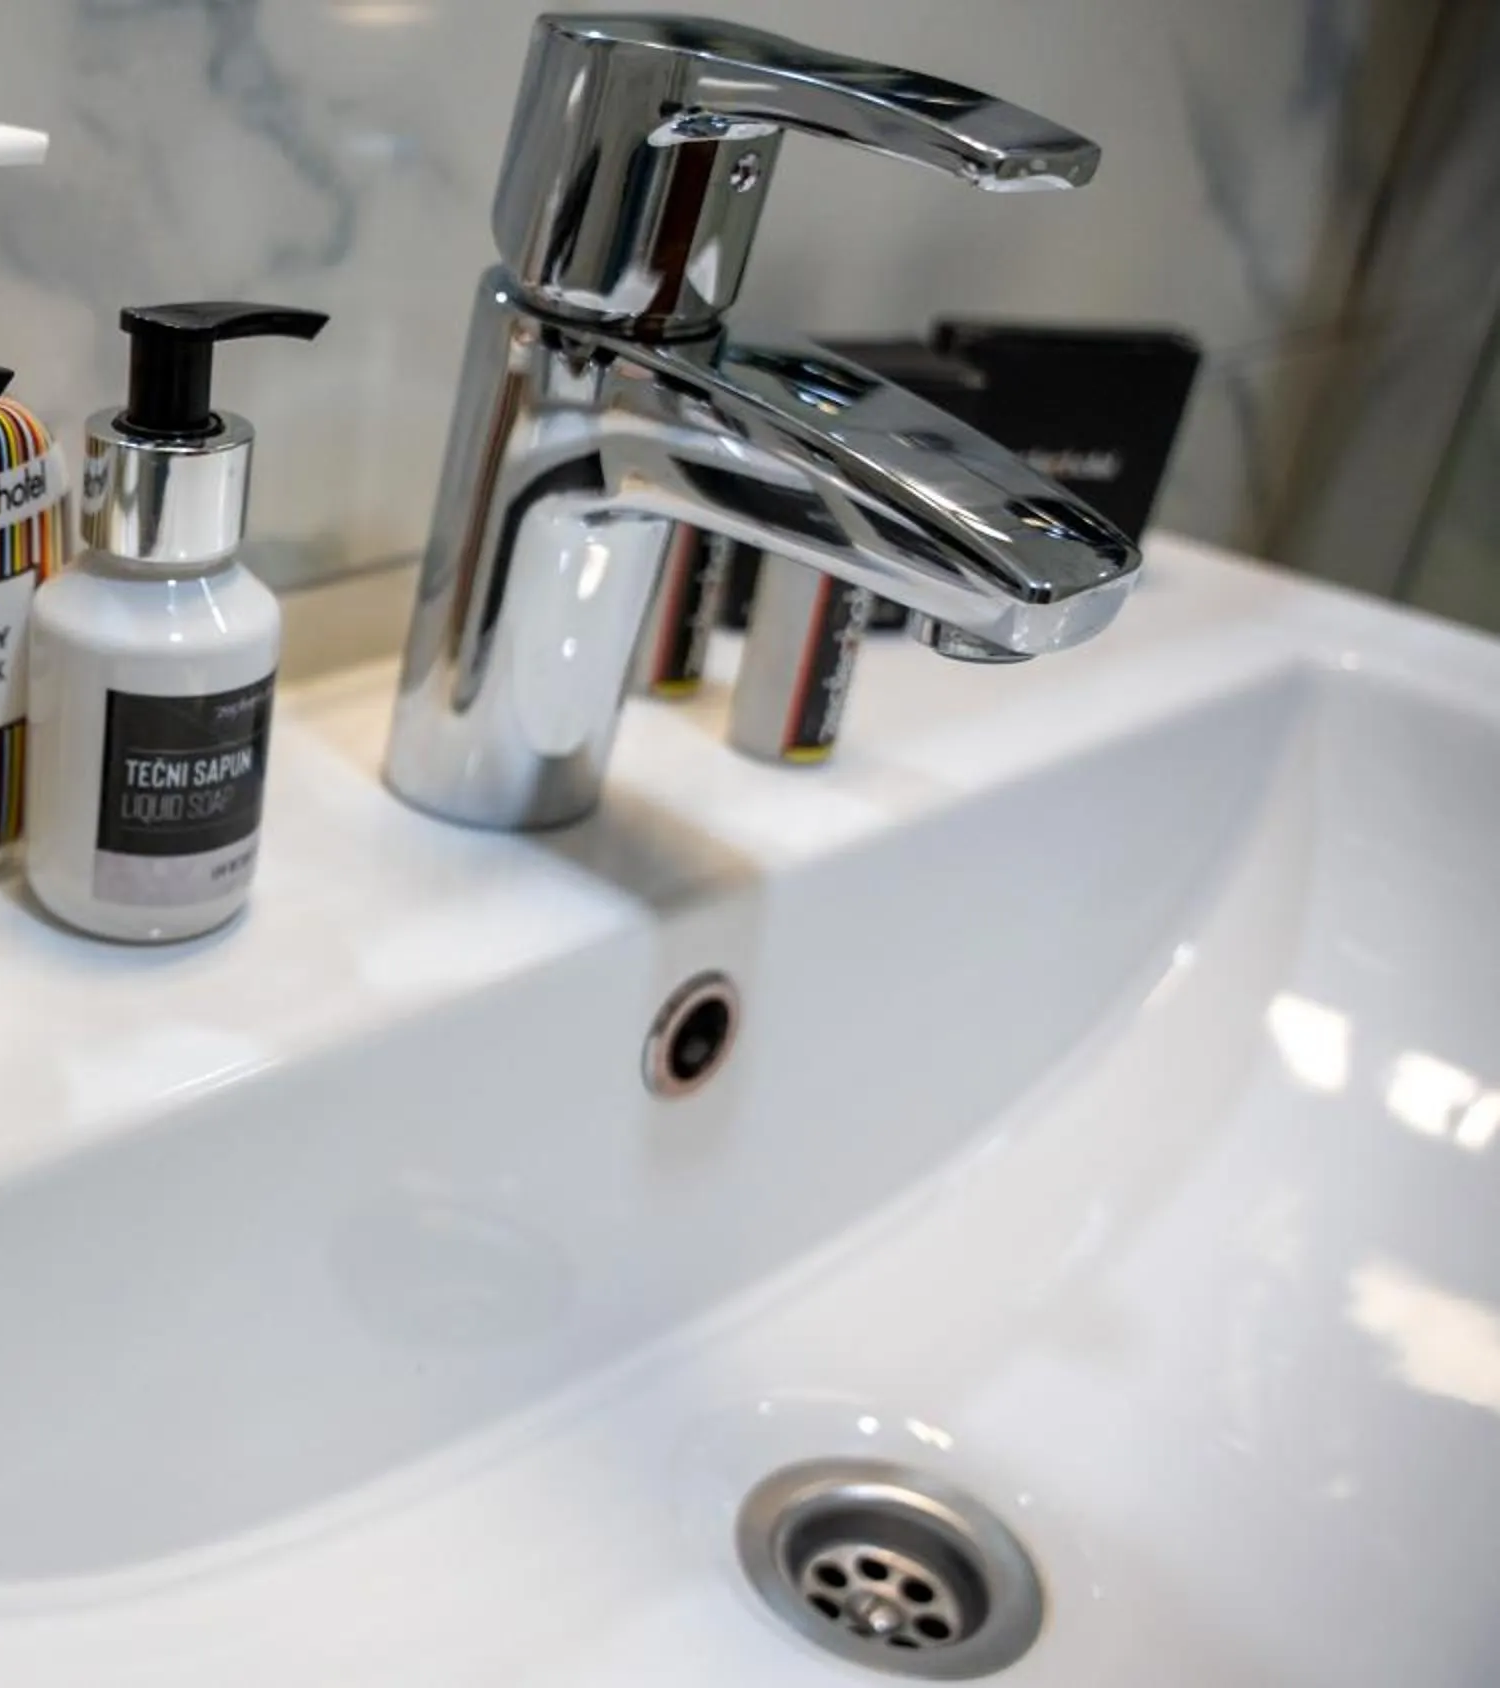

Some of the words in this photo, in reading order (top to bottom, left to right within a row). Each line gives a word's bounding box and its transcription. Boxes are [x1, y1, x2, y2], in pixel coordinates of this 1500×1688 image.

[125, 756, 189, 788] TEČNI
[192, 746, 253, 787] SAPUN
[120, 792, 185, 824] LIQUID
[185, 784, 236, 820] SOAP
